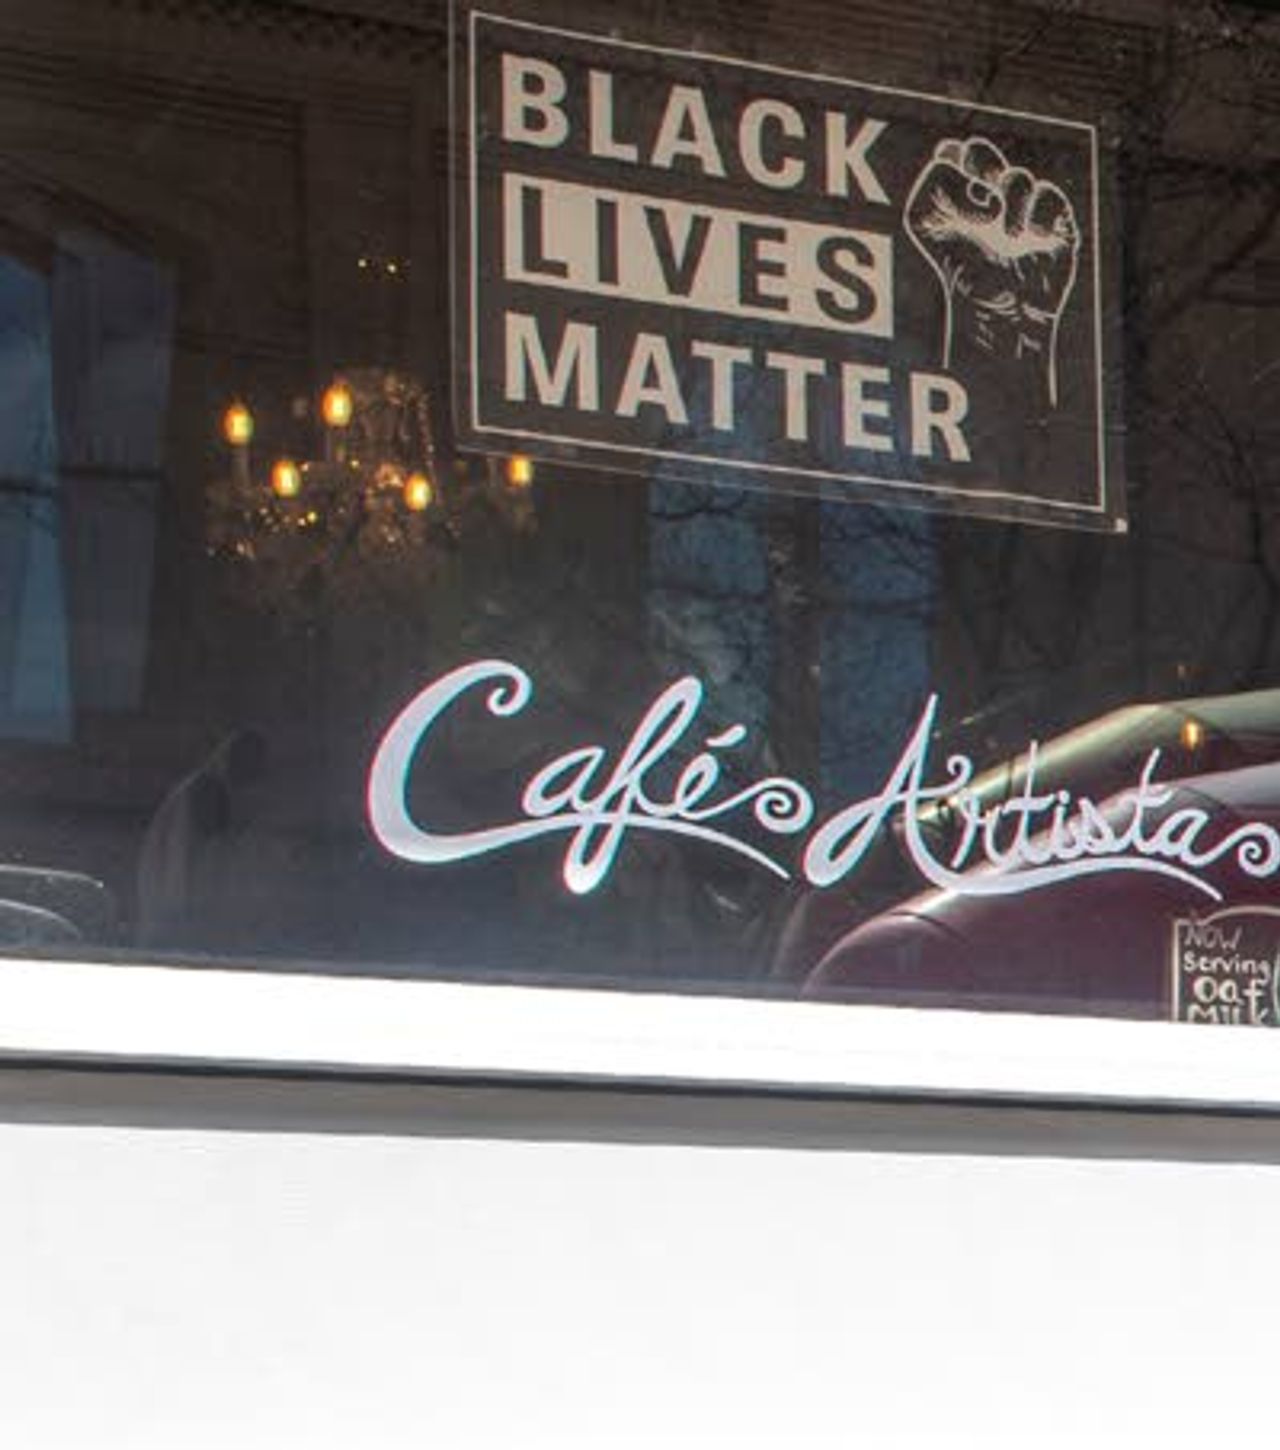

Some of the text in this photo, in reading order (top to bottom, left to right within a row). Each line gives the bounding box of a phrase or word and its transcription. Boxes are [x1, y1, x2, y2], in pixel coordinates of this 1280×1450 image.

[502, 53, 891, 206] BLACK
[521, 186, 879, 326] LIVES
[504, 311, 972, 464] MATTER
[368, 660, 813, 894] Café
[1183, 951, 1271, 982] Serving
[1193, 975, 1265, 1007] Oat
